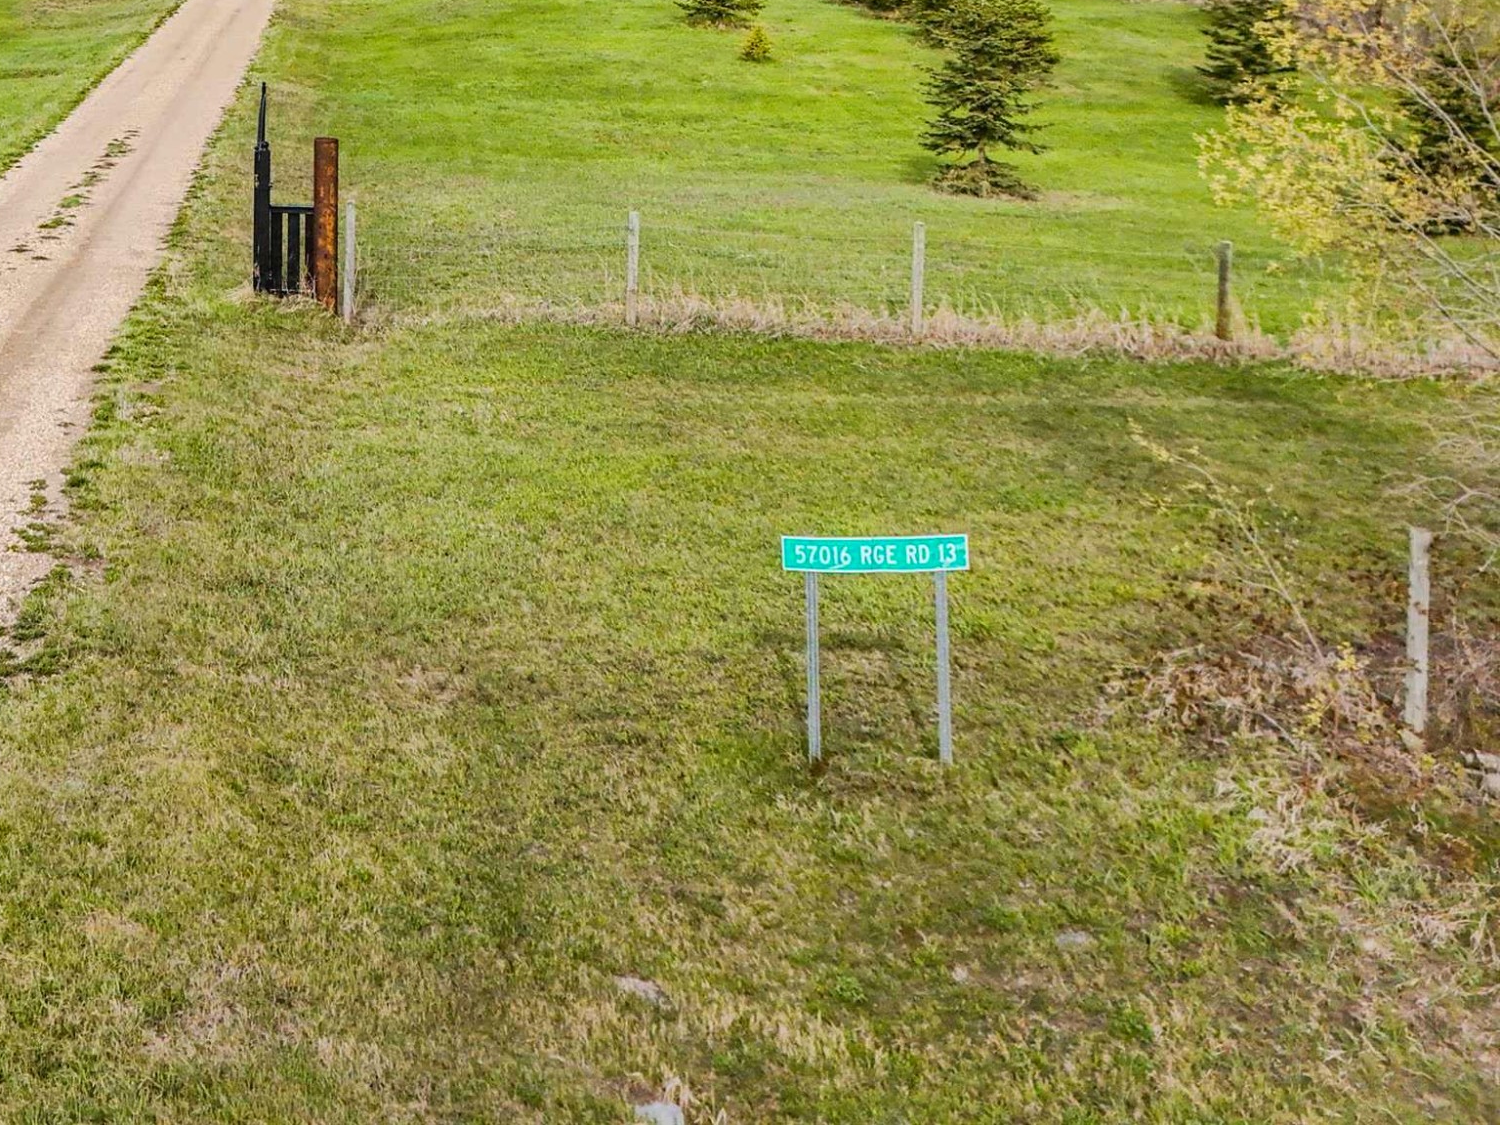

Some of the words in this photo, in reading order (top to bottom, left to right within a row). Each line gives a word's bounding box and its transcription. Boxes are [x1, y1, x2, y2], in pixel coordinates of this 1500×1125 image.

[794, 544, 852, 565] 57016
[860, 544, 897, 565] RGE
[905, 544, 930, 564] RD
[937, 542, 957, 563] 13
